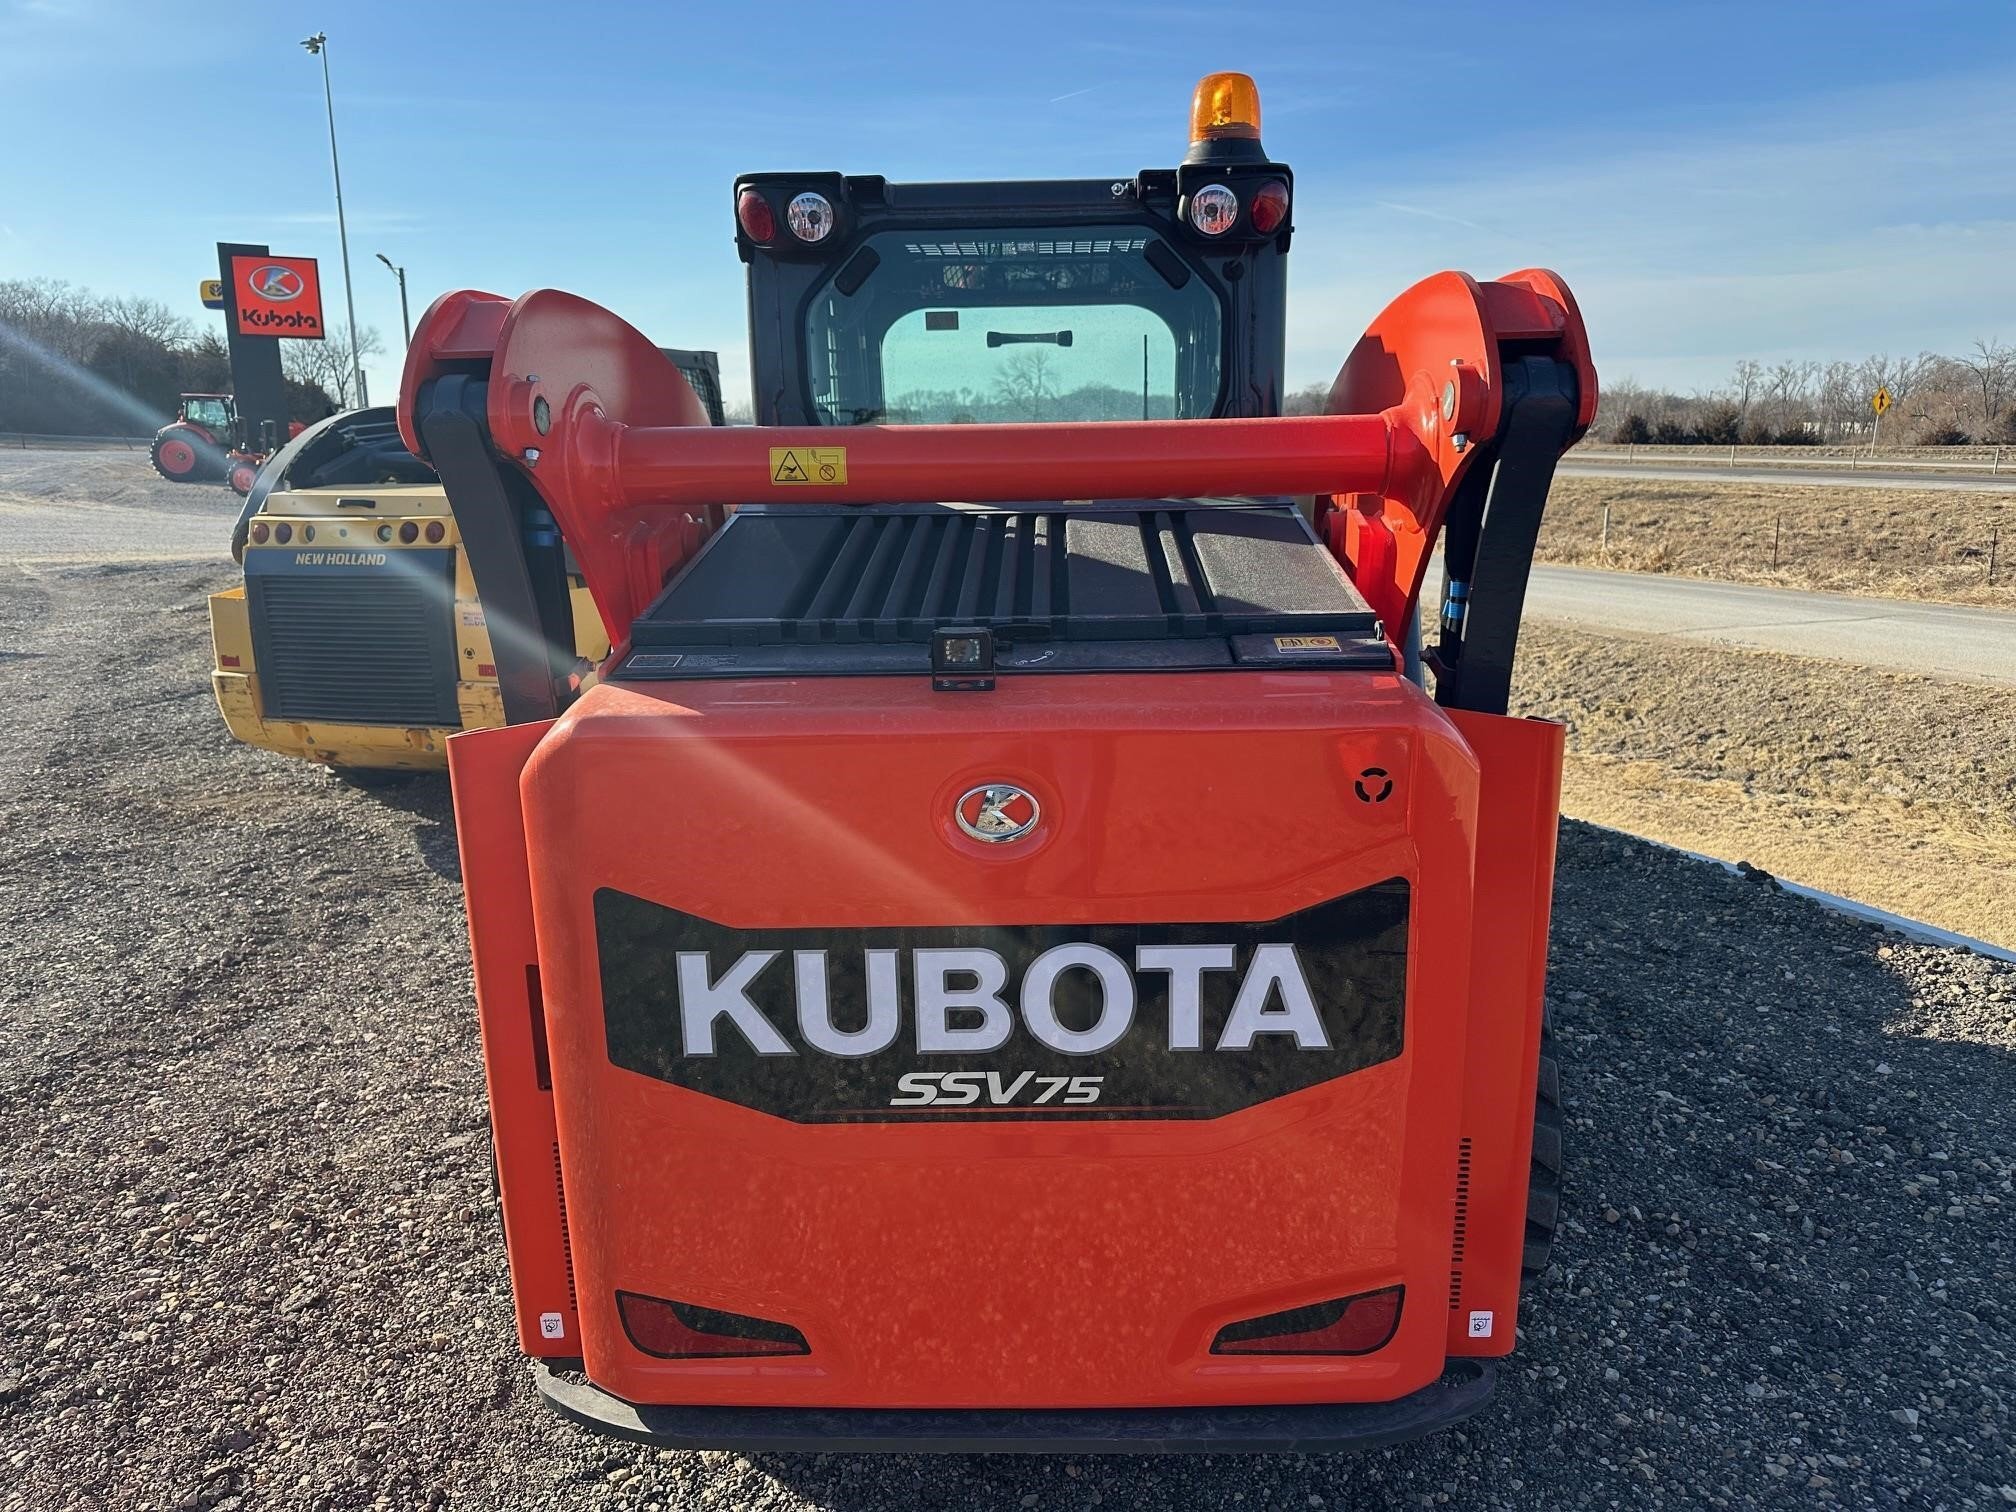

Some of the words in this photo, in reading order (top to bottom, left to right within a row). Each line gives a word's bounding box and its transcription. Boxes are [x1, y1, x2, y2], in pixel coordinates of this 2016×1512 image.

[242, 308, 317, 328] Kubota
[295, 553, 324, 565] NEW
[326, 553, 386, 566] HOLLAND
[675, 942, 1332, 1057] KUBOTA
